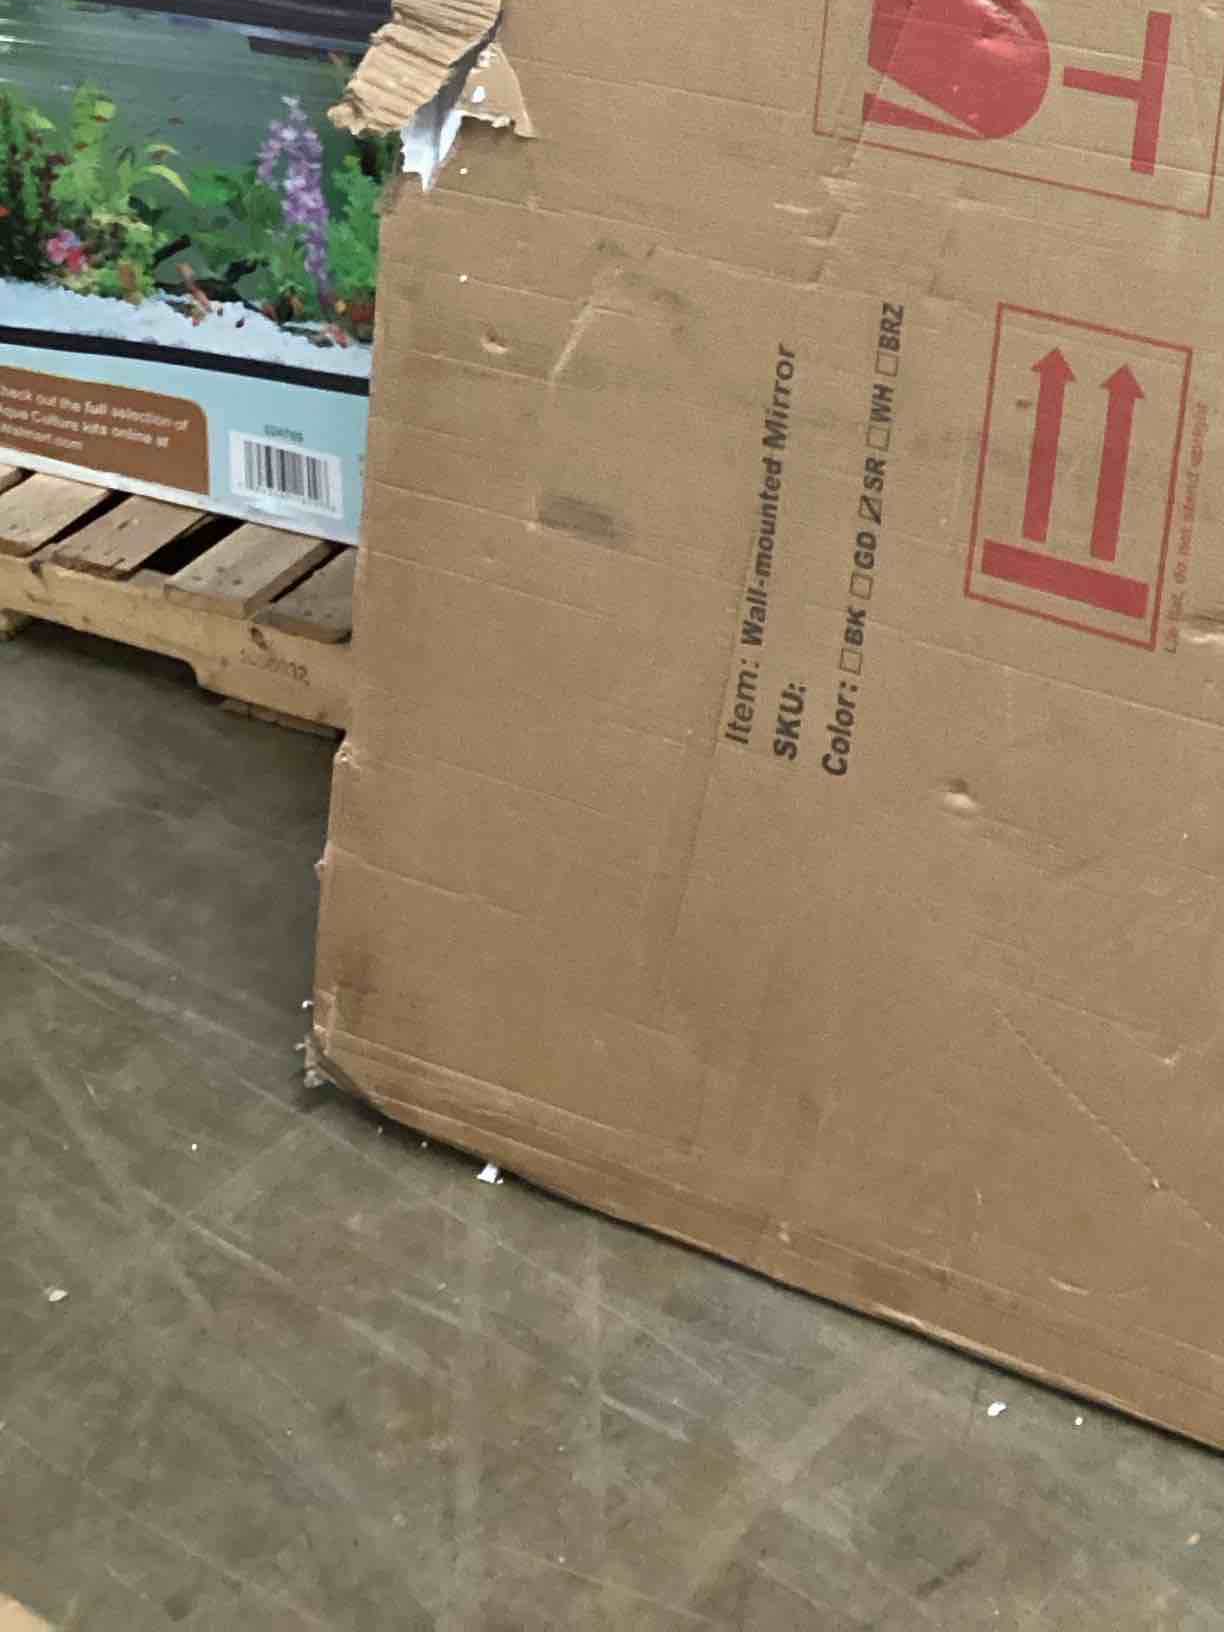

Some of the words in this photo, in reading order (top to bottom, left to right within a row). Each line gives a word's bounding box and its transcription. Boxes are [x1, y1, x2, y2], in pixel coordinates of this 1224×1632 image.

[761, 342, 796, 451] Mirror
[740, 456, 784, 647] Wall-mounted
[725, 658, 761, 745] Item:
[773, 682, 807, 761] SKU:
[821, 680, 859, 777] Color:
